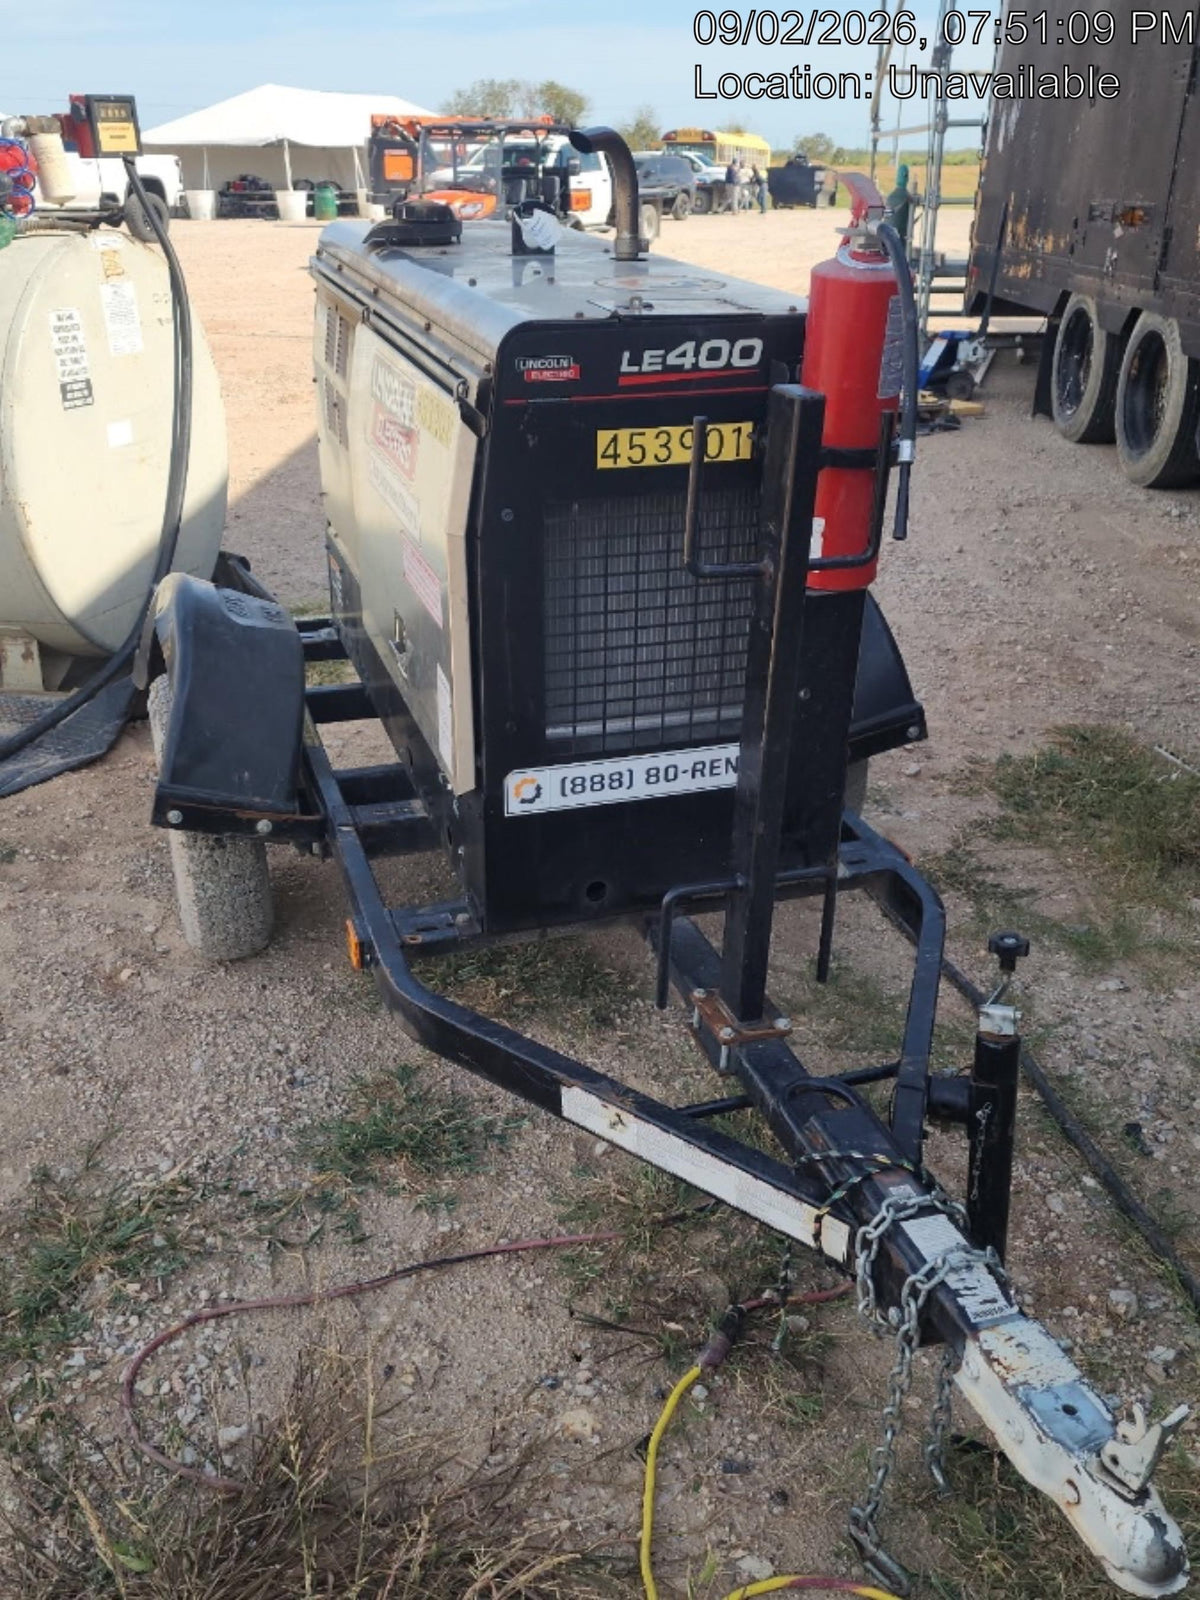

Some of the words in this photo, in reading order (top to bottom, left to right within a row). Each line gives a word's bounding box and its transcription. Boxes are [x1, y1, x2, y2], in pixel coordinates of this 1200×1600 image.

[519, 357, 570, 370] LINCOLN
[620, 337, 763, 373] LE400
[560, 768, 634, 797] (888)
